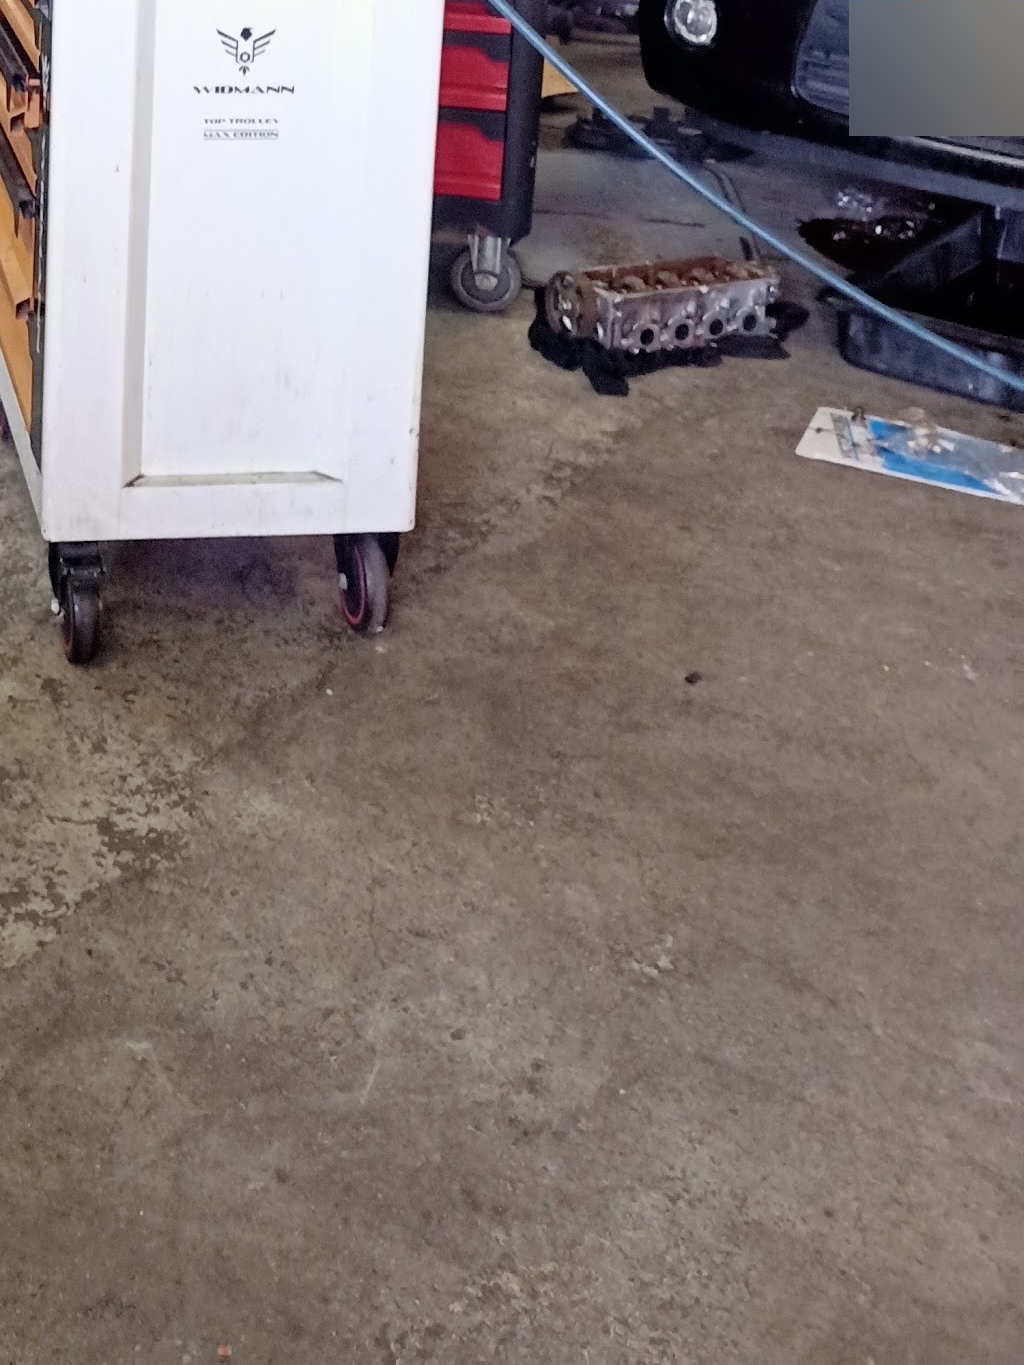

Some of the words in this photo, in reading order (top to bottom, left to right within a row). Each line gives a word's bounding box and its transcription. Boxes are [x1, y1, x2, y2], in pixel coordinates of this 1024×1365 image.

[193, 85, 295, 95] WIDMANN
[203, 117, 226, 125] TOP
[228, 117, 279, 125] TROLLEY
